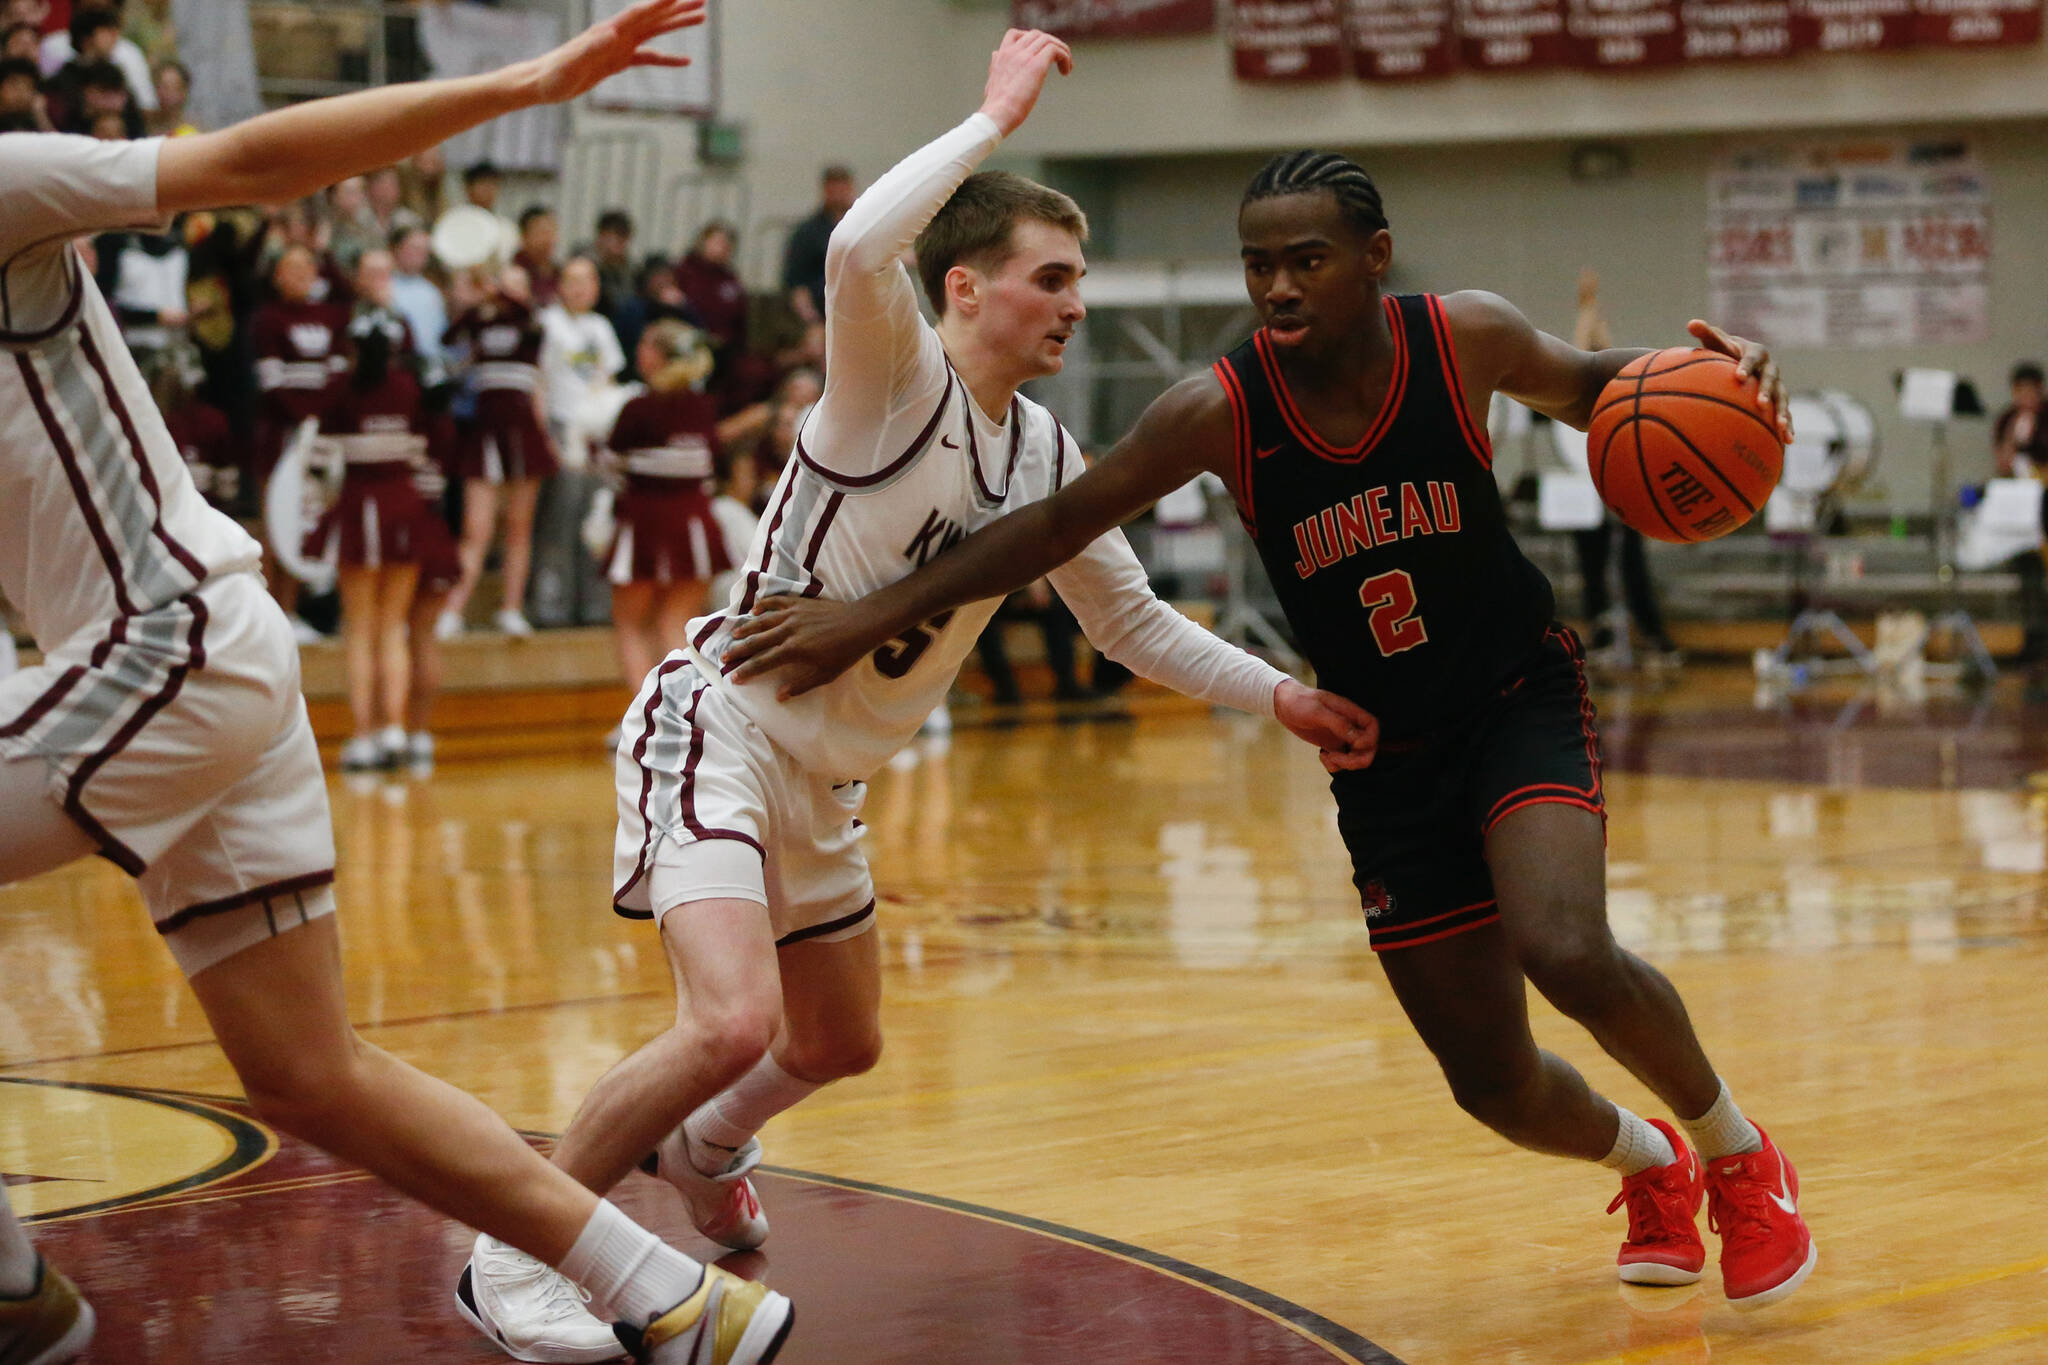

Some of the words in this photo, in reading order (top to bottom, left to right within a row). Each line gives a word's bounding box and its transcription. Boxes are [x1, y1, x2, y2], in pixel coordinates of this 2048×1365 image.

[1293, 481, 1461, 579] JUNEAU
[1659, 460, 1717, 516] THE
[1358, 568, 1429, 657] 2
